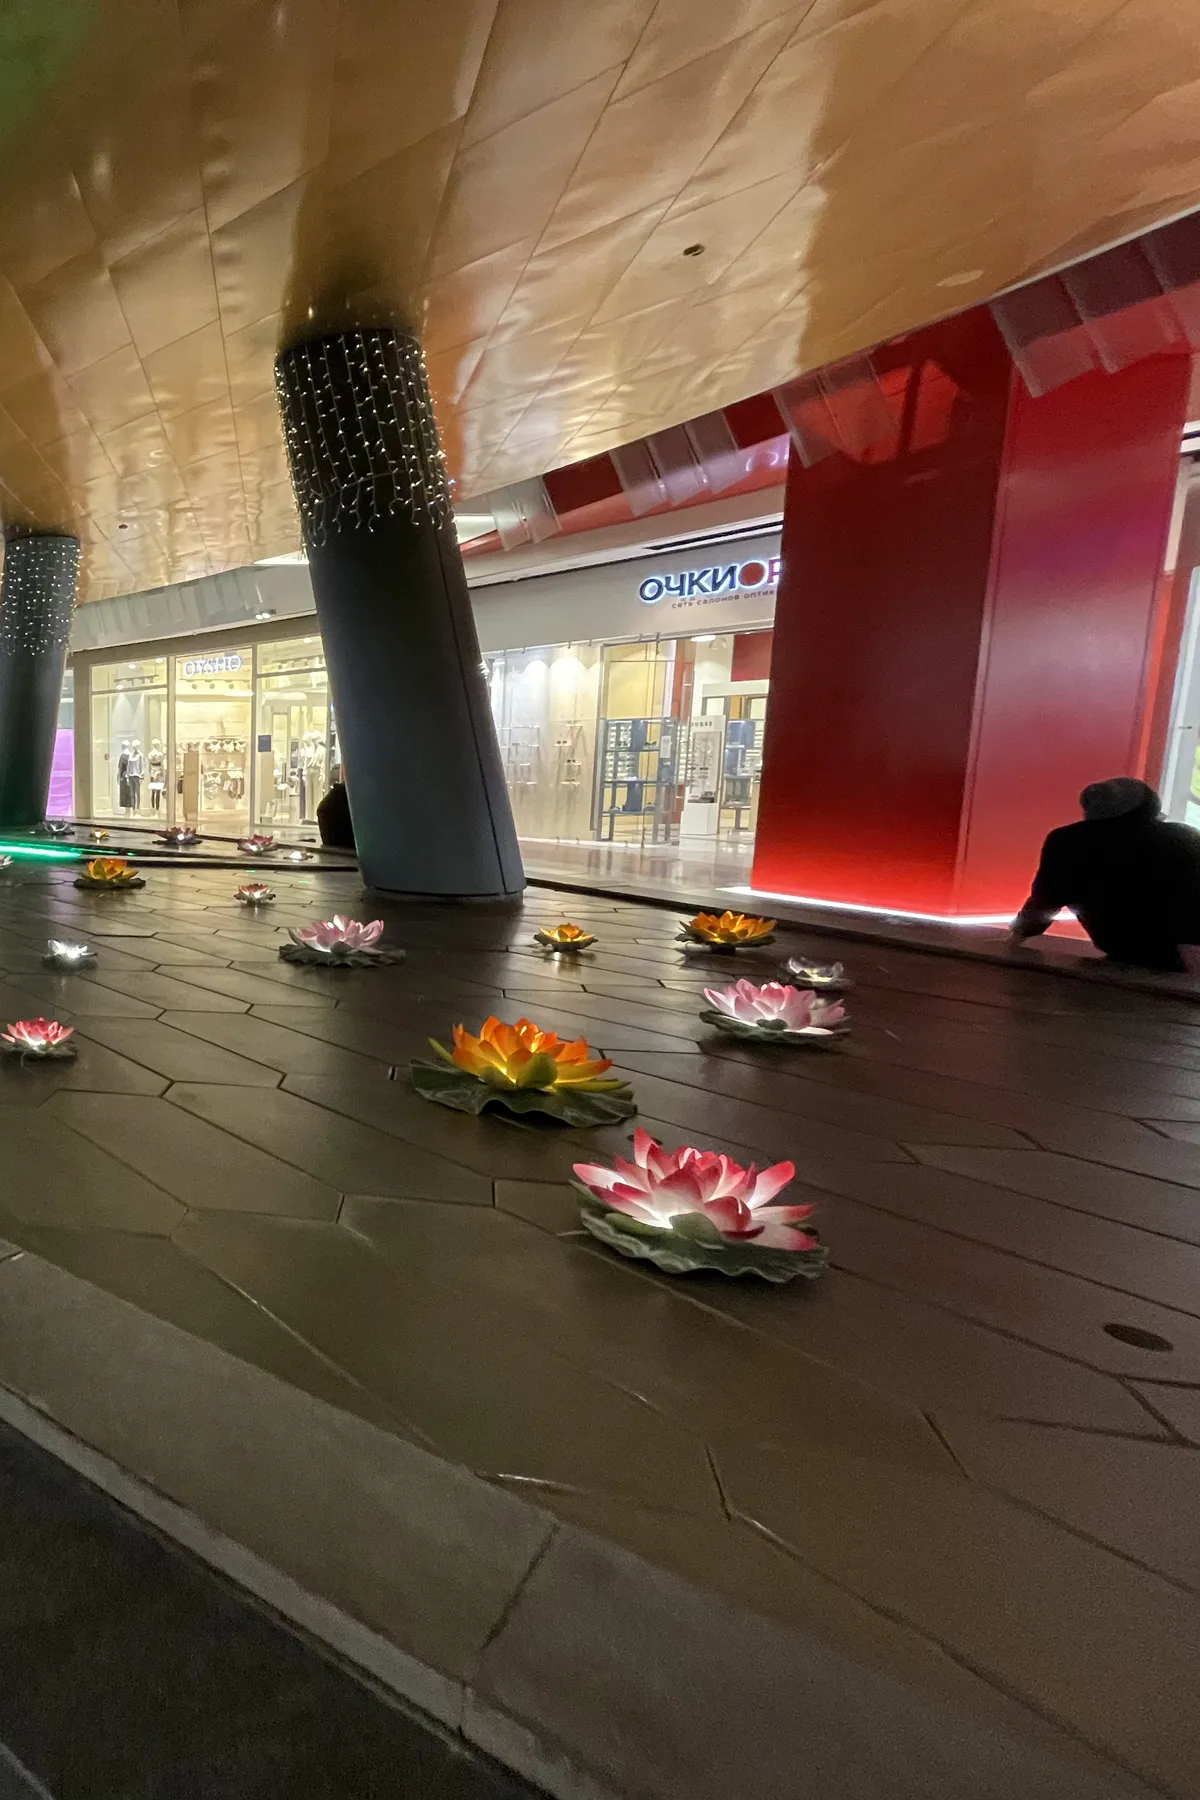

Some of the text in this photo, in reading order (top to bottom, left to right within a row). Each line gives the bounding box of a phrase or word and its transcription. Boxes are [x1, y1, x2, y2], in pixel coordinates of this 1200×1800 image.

[671, 601, 693, 609] сеть
[696, 595, 740, 606] салонов
[183, 654, 242, 678] OYSHO
